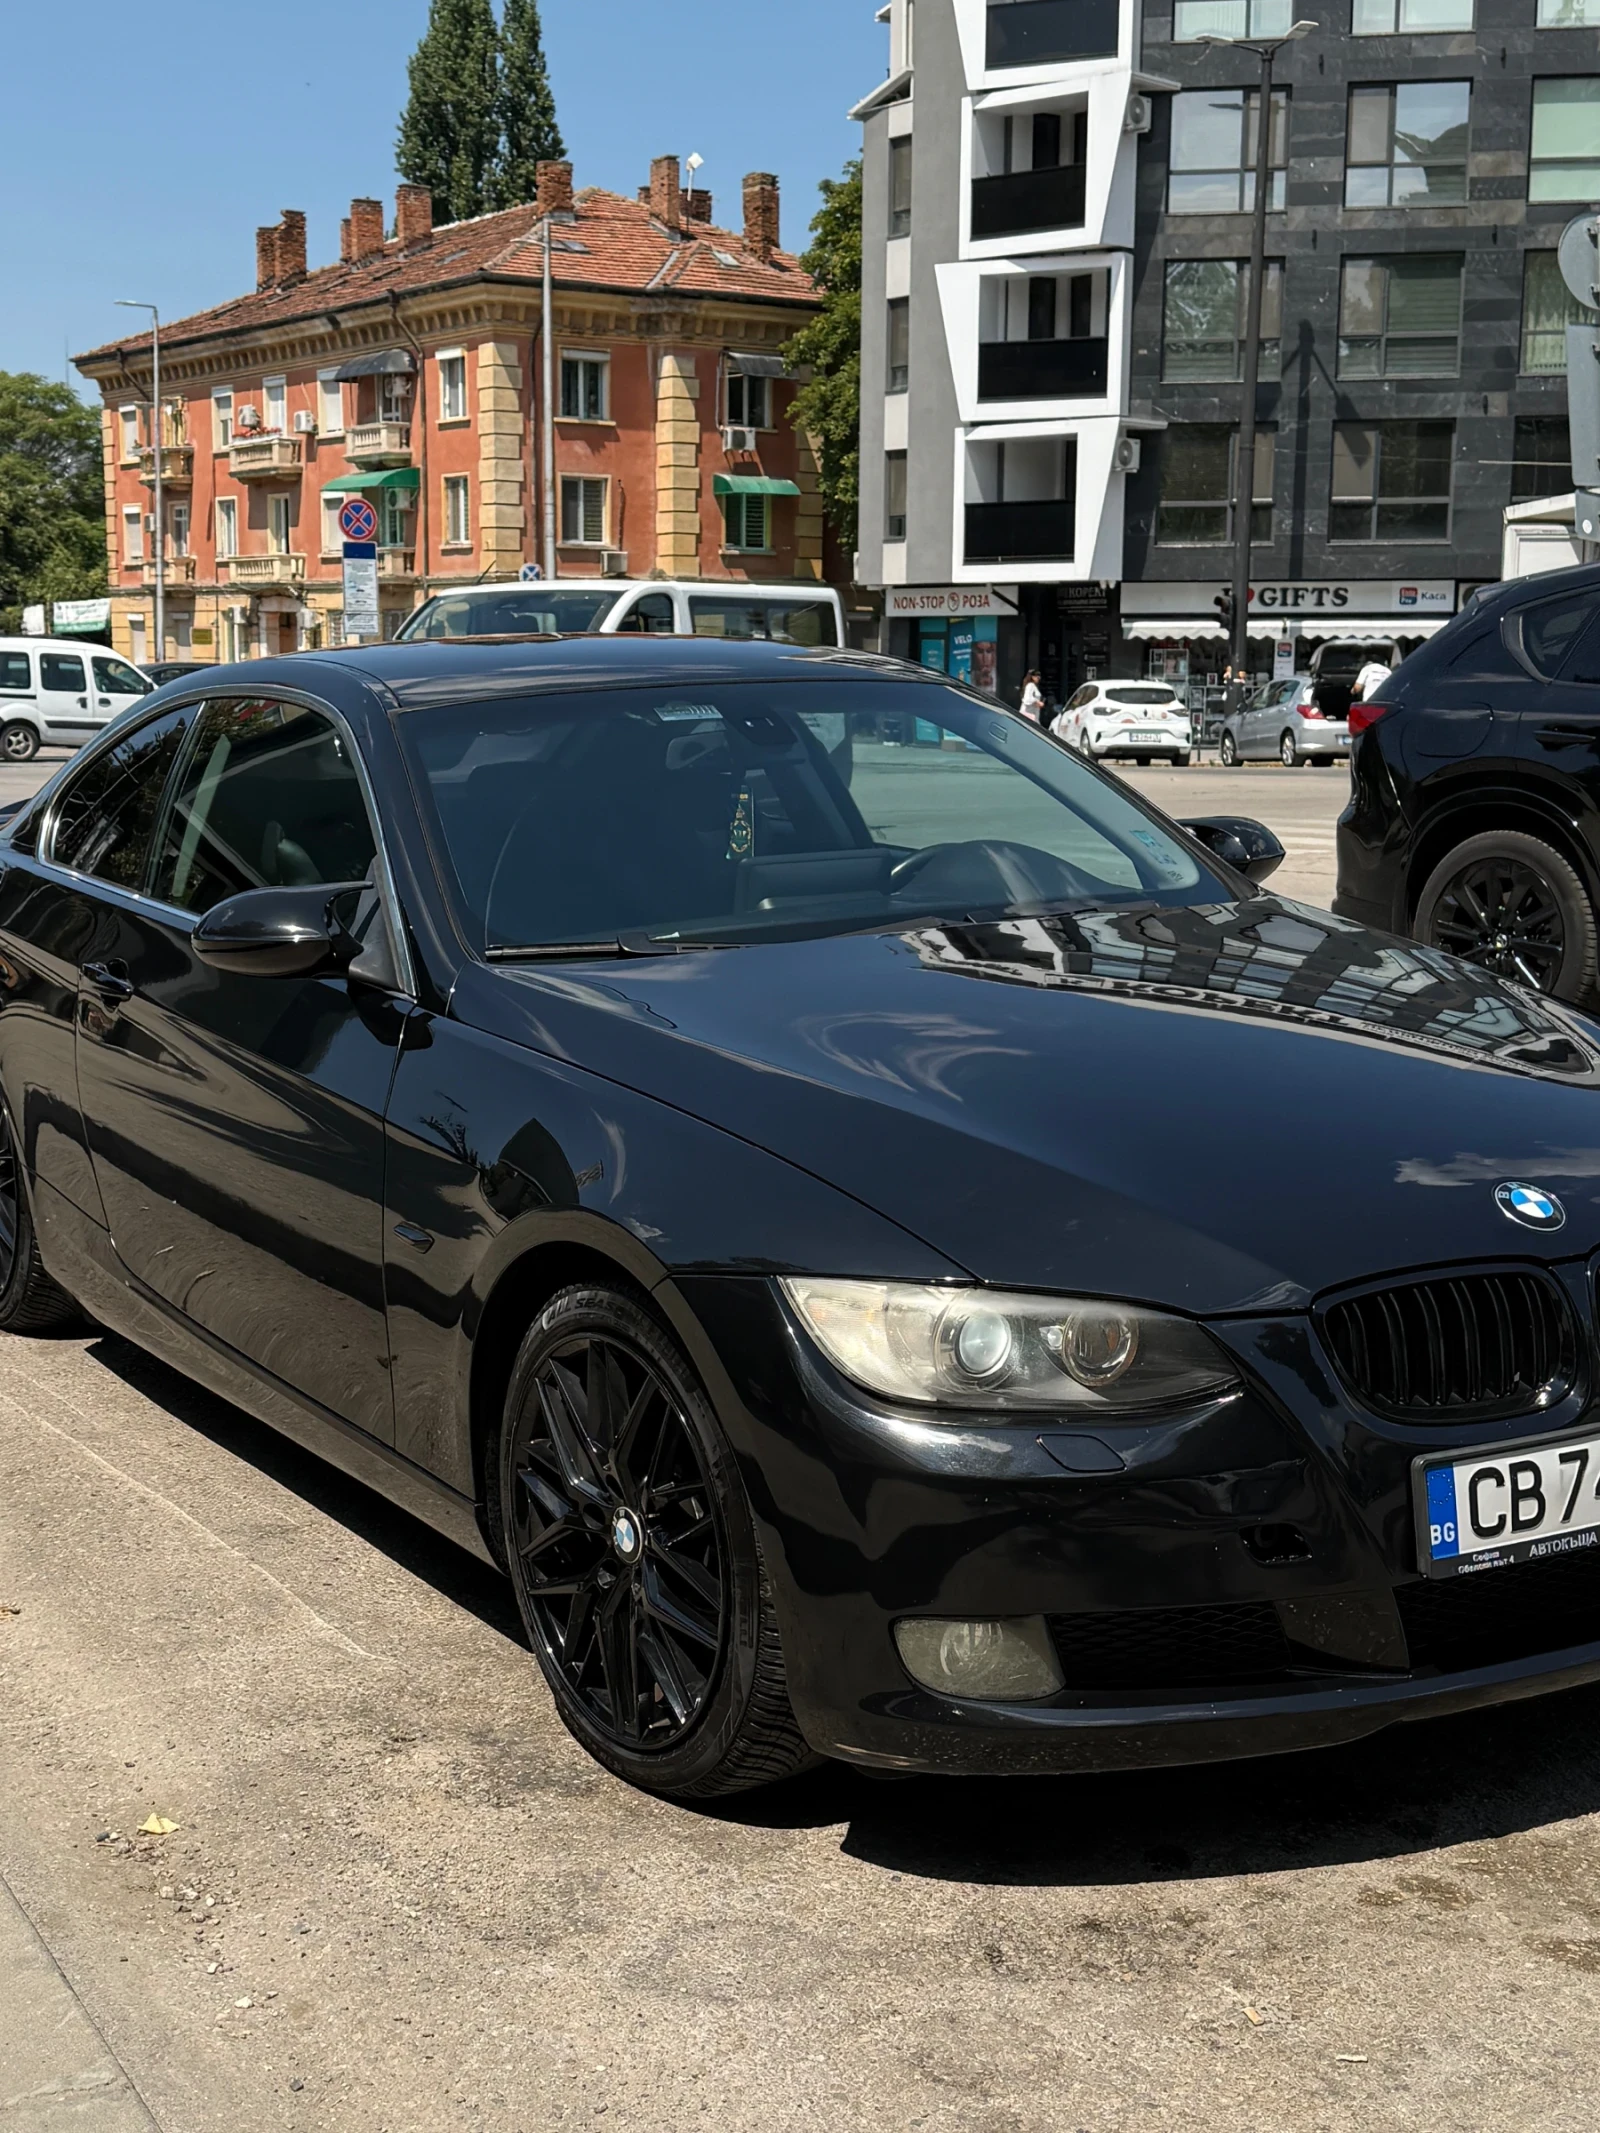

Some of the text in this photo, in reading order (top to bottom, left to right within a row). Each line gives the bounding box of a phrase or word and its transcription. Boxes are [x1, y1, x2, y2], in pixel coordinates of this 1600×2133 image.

[893, 594, 990, 609] NON-STOP РОЗА
[1258, 587, 1349, 607] GIFTS
[1421, 592, 1446, 600] Каса
[954, 634, 973, 645] VELO
[1469, 1449, 1600, 1538] CB 7
[1430, 1522, 1455, 1546] BG
